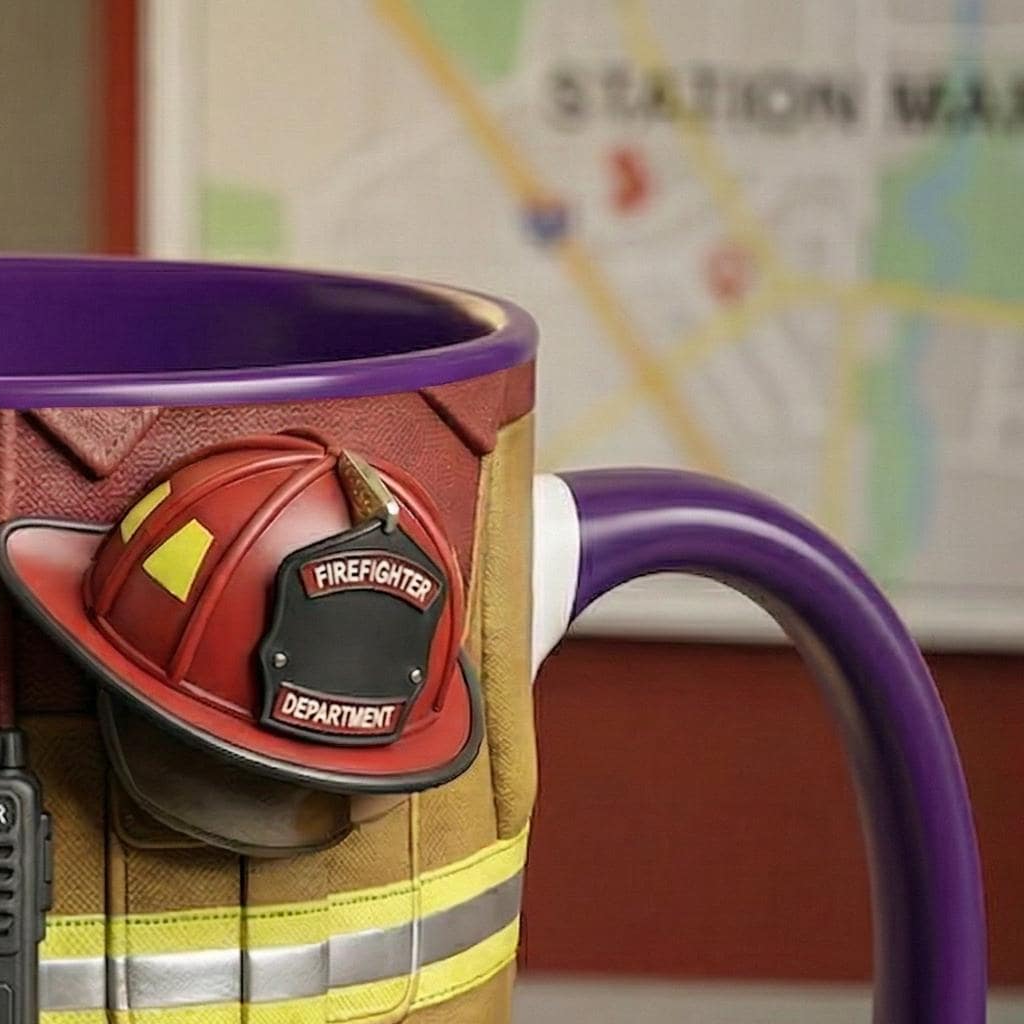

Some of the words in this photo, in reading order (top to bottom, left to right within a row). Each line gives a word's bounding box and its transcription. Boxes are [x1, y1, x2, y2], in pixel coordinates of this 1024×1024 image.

[548, 64, 860, 131] STATION
[314, 559, 432, 602] FIREFIGHTER
[281, 692, 395, 728] DEPARTMENT
